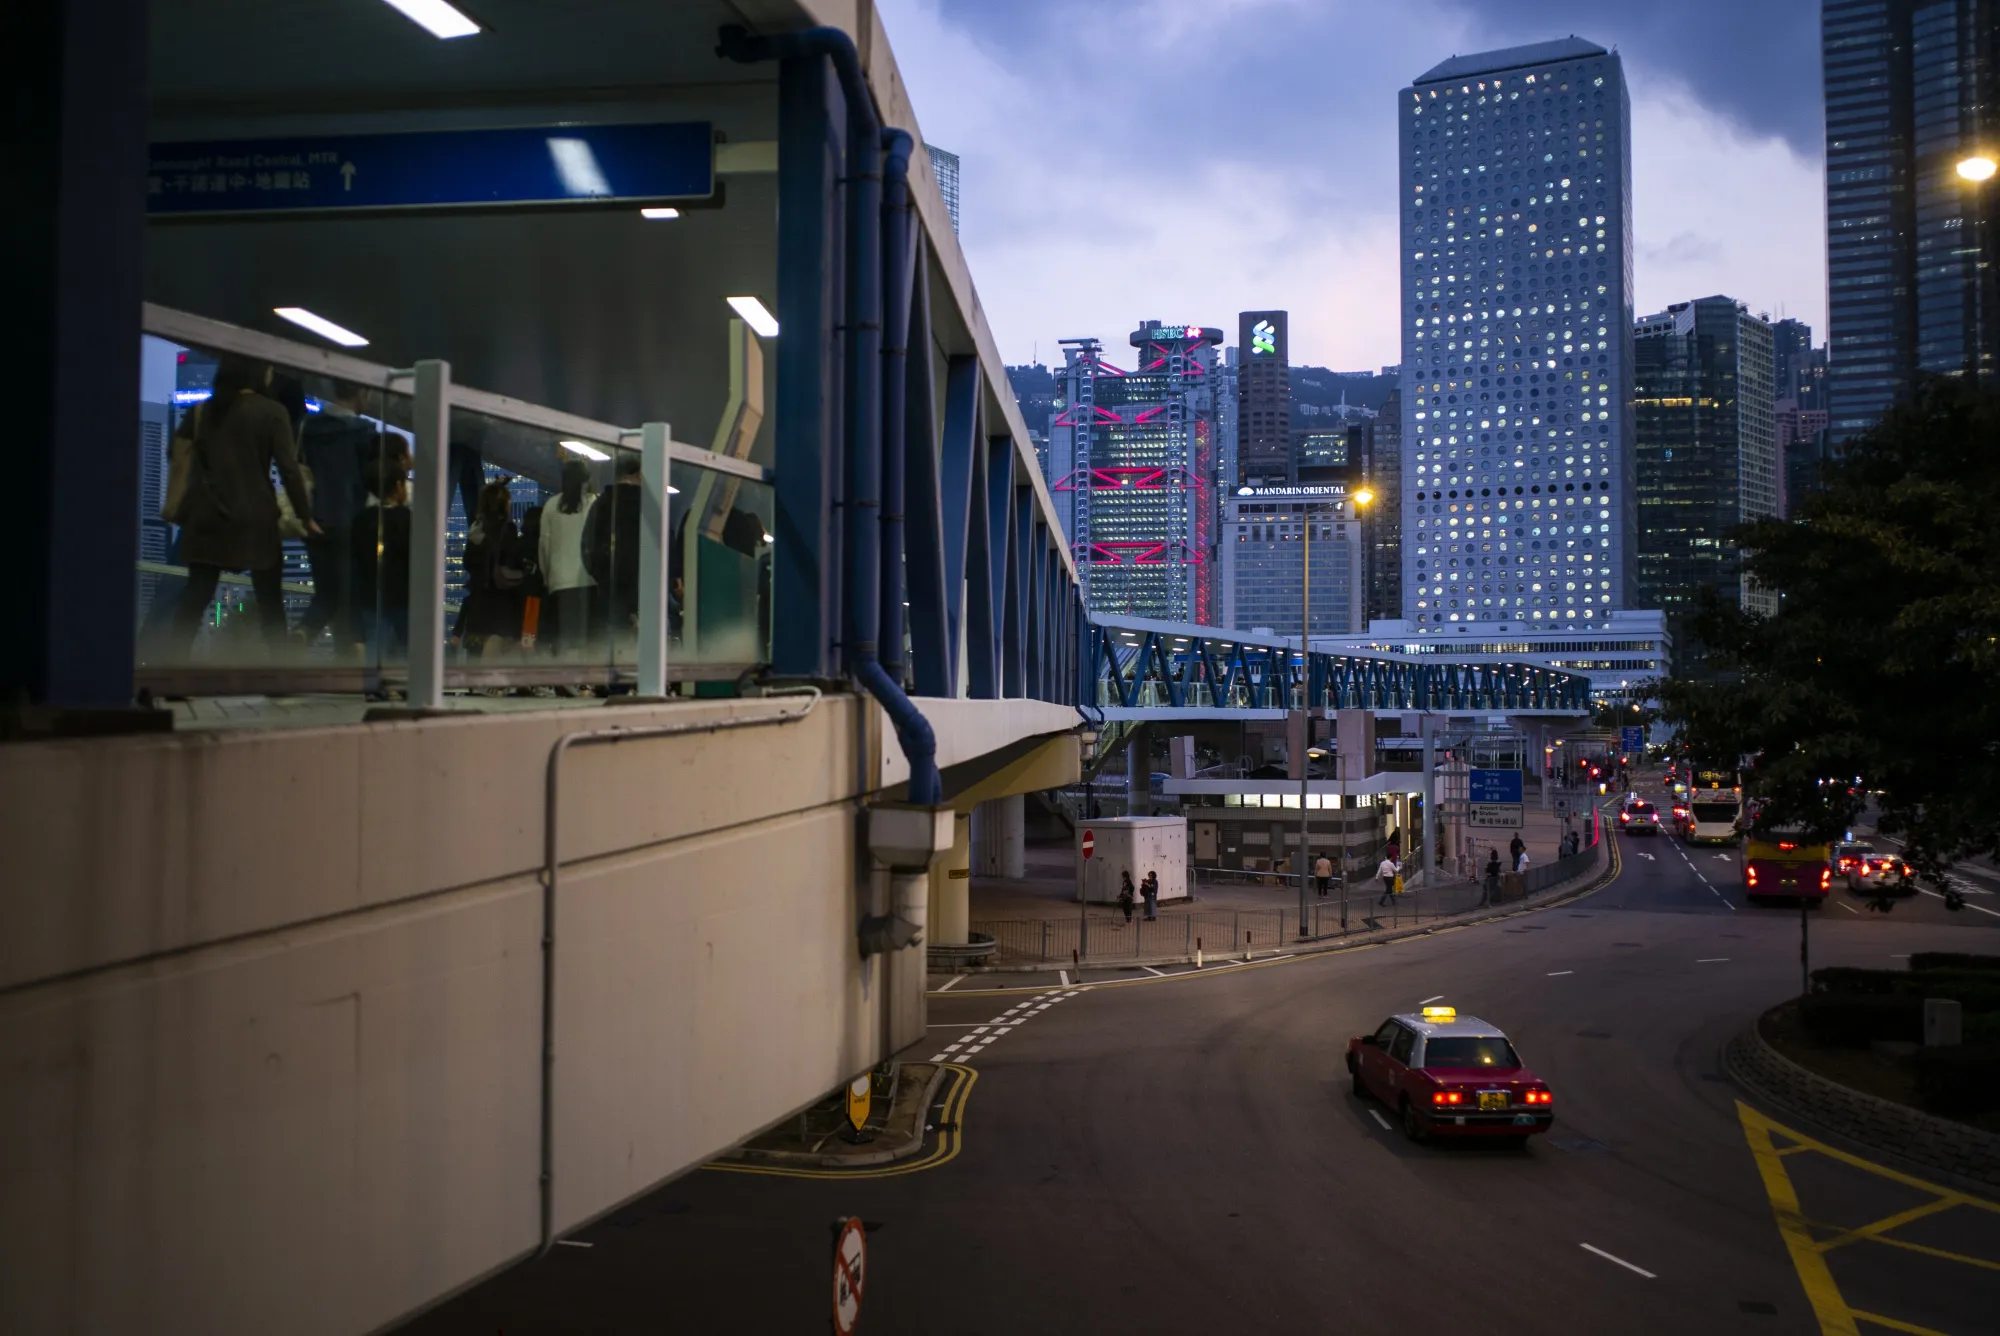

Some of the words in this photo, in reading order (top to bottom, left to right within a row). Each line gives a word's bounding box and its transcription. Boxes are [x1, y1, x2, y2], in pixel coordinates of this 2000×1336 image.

[308, 151, 338, 165] MTR
[1151, 328, 1185, 340] HSBC
[1255, 487, 1302, 495] MANDARIN
[1302, 486, 1346, 494] ORIENTAL
